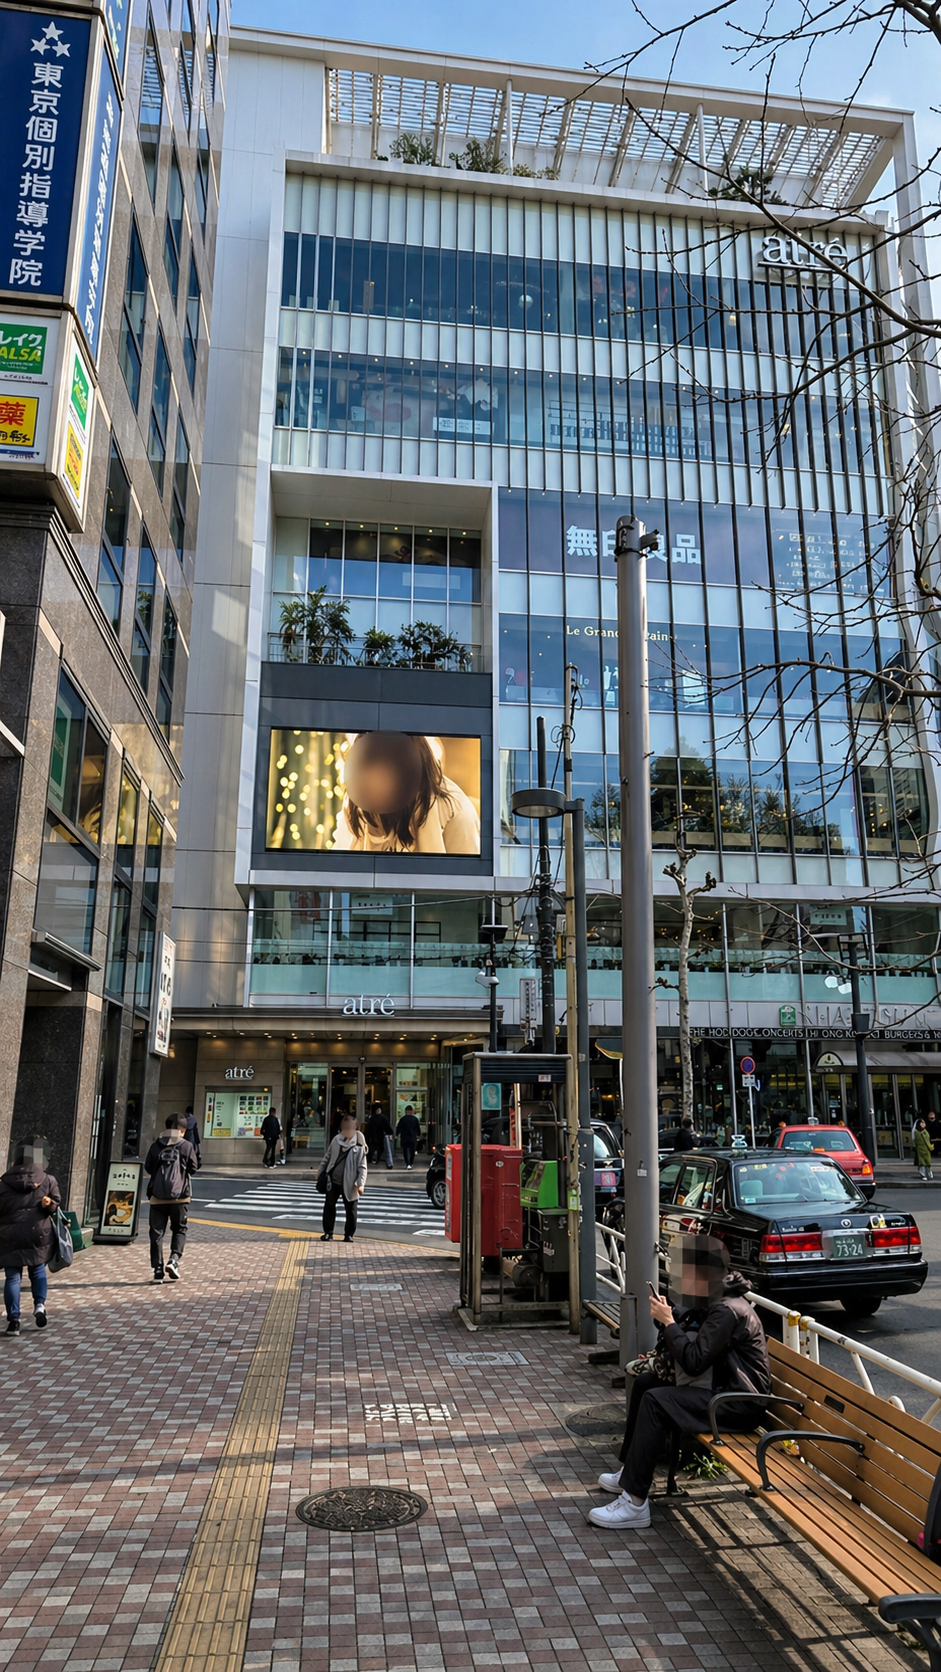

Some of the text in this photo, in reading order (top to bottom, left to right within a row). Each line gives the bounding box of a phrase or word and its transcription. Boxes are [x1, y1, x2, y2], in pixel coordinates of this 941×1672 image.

[9, 62, 64, 286] 東京個別指導学院
[762, 236, 848, 270] atré
[566, 625, 580, 636] Le
[343, 993, 395, 1016] atré
[224, 1065, 254, 1079] atré
